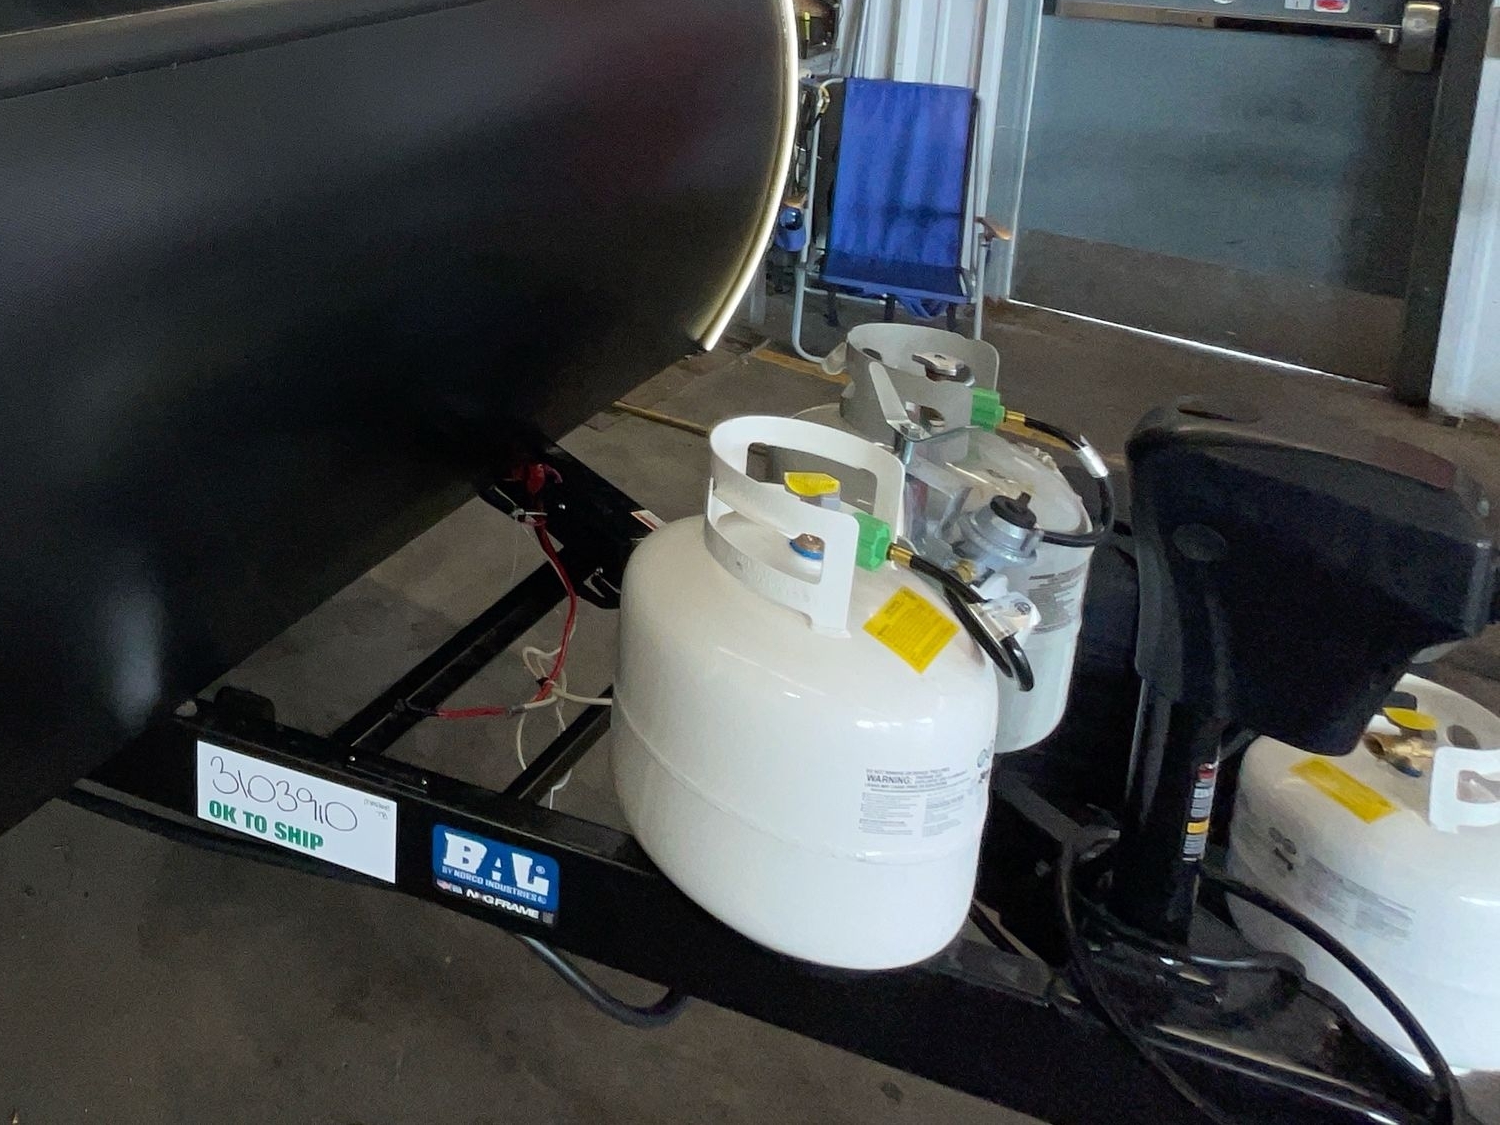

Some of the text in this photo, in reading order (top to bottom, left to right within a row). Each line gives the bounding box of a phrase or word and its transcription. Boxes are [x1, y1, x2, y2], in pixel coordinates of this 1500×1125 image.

[209, 800, 324, 850] OK TO SHIP
[442, 865, 536, 901] BY NORCO INDUSTRIES
